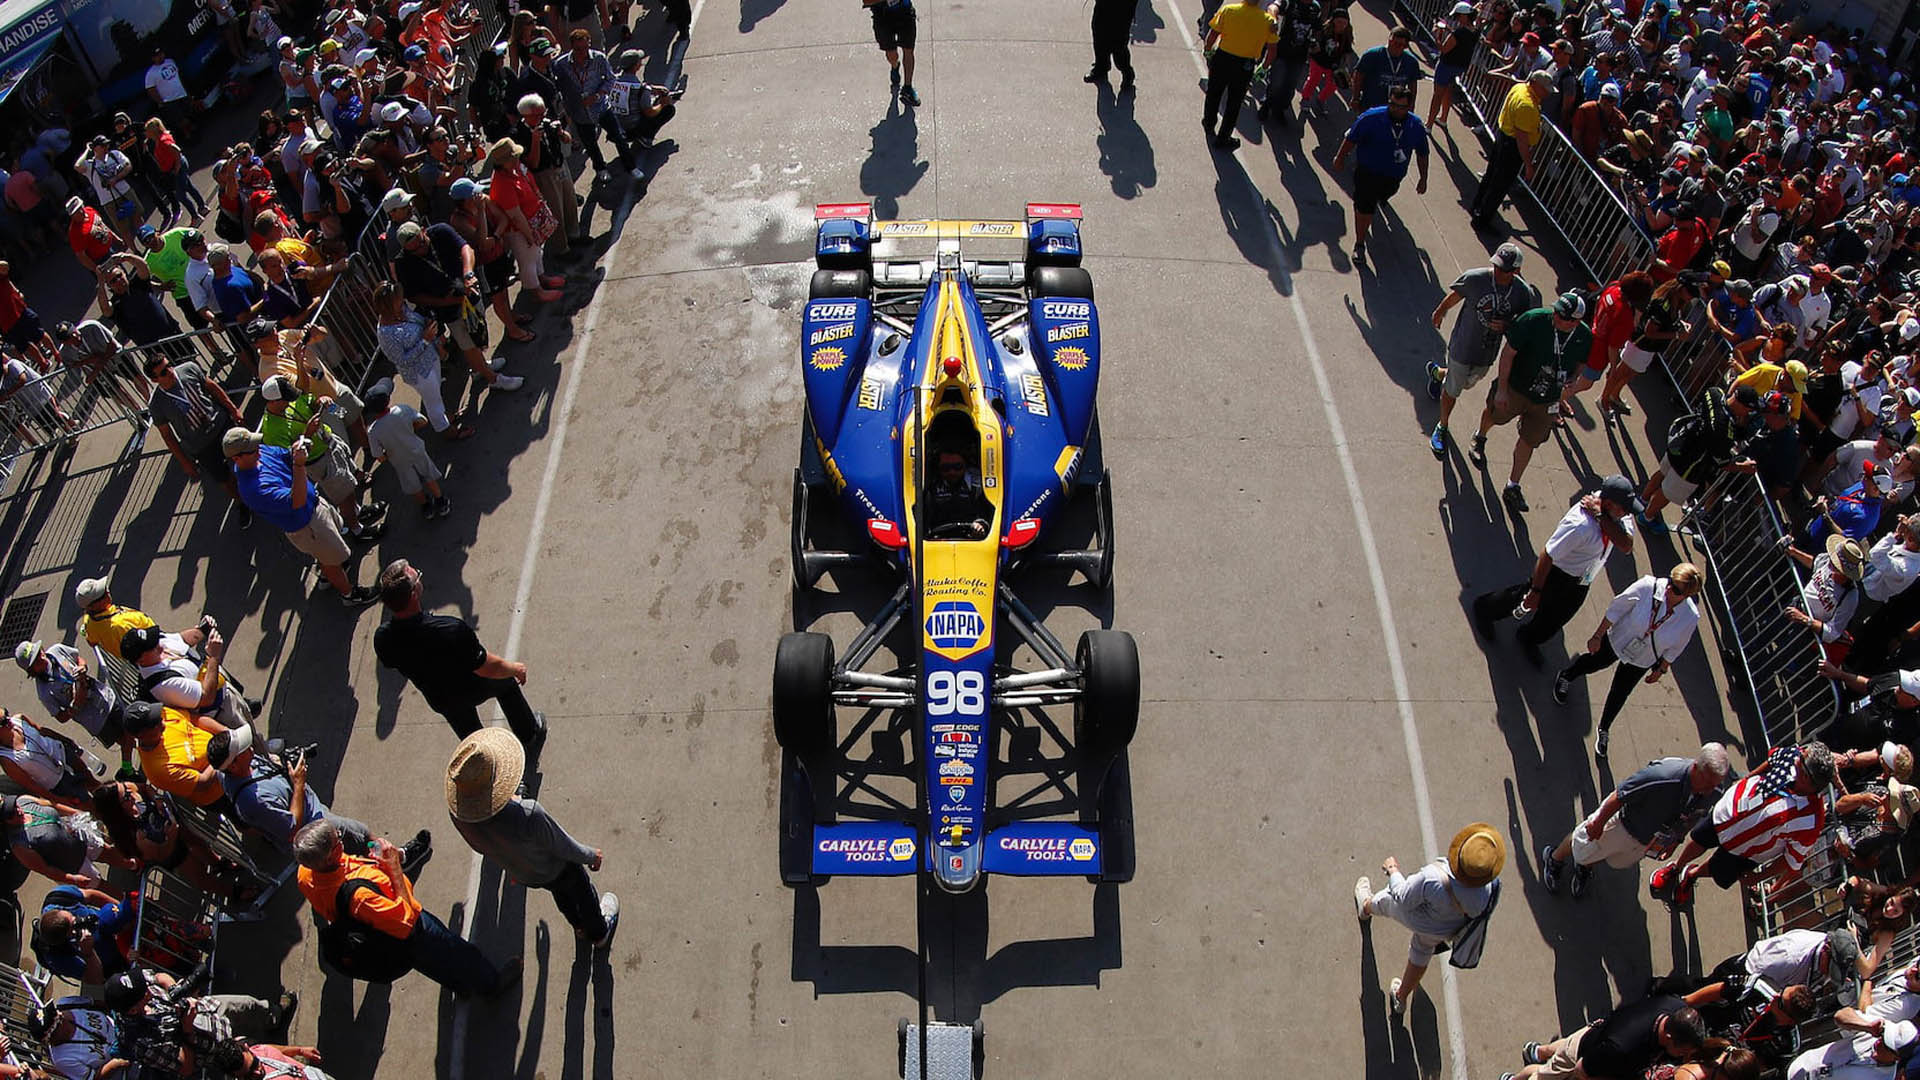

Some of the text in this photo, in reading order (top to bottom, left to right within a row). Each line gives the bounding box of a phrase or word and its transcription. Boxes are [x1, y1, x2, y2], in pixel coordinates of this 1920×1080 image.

[884, 223, 928, 235] BLASTER
[971, 223, 1015, 235] BLASTER
[810, 306, 856, 318] CURB
[1044, 304, 1090, 316] CURB
[810, 325, 854, 345] BLASTER
[1048, 325, 1089, 343] BLASTER
[1023, 374, 1049, 416] BLASTER
[855, 488, 889, 521] Firesto
[924, 587, 969, 597] Roasting
[935, 614, 977, 636] NAPA
[928, 671, 984, 715] 98
[819, 839, 887, 852] CARLYLE
[846, 852, 886, 862] TOOLS
[893, 844, 913, 856] NAPA
[1000, 838, 1067, 851] CARLYLE
[1026, 851, 1066, 861] TOOLS
[1073, 844, 1093, 855] NAPA
